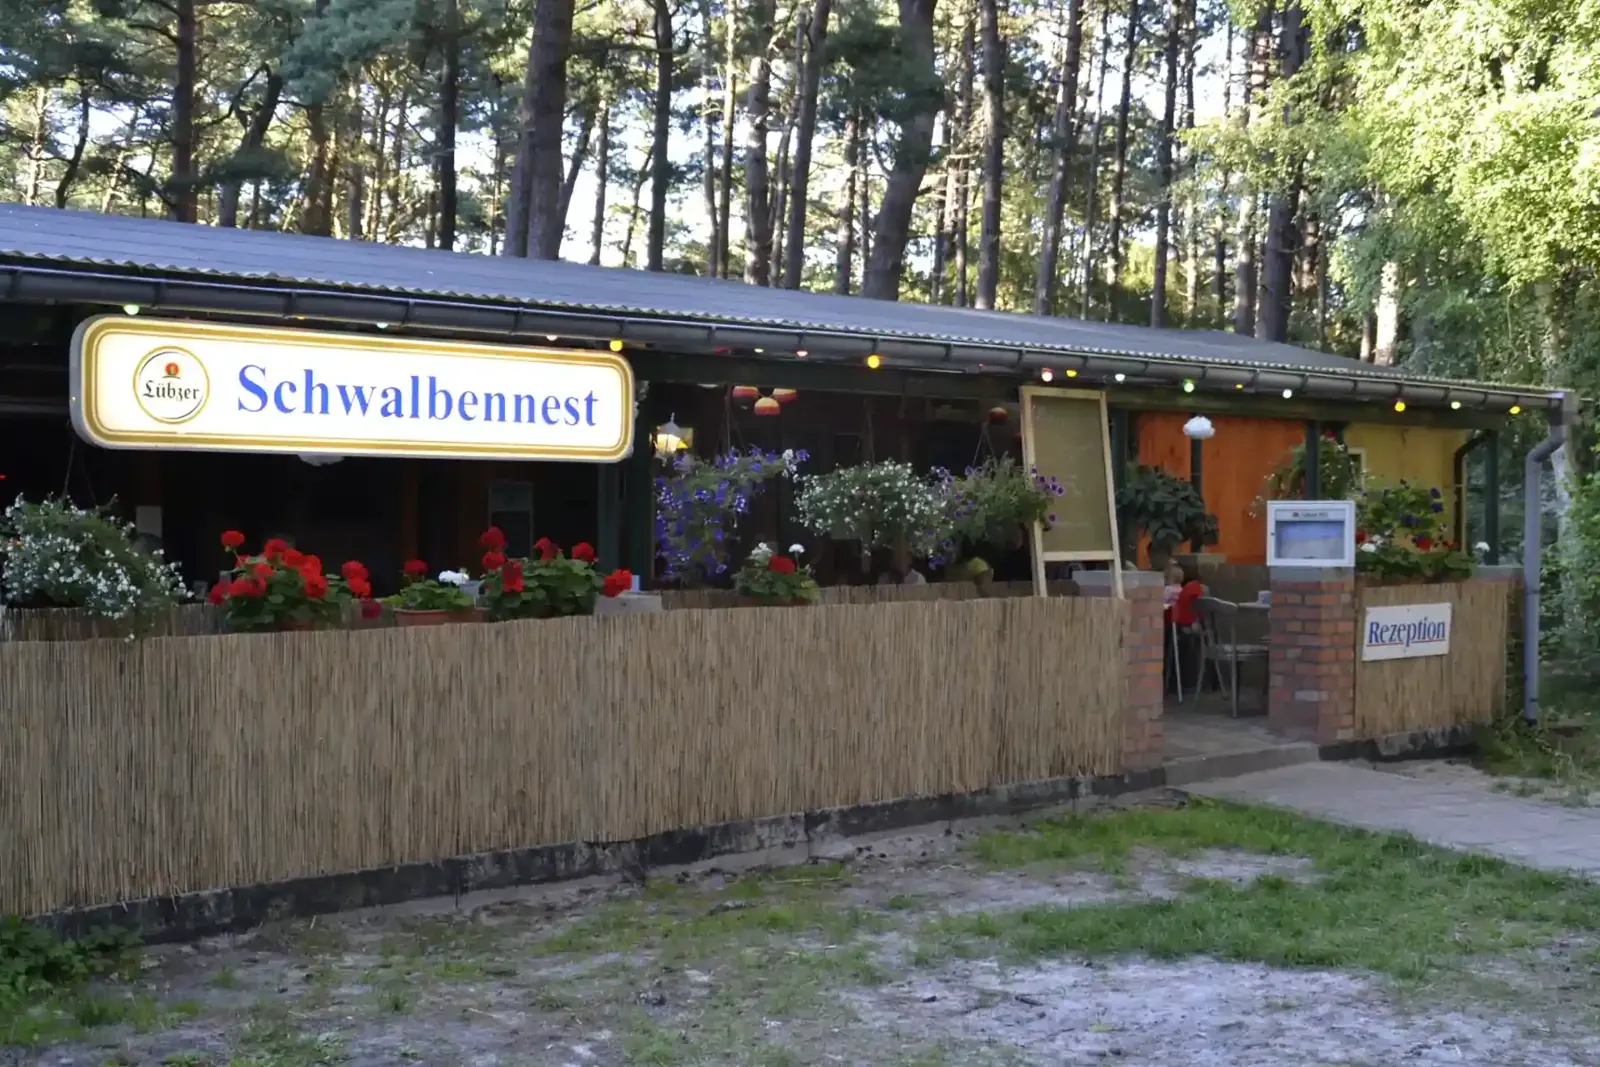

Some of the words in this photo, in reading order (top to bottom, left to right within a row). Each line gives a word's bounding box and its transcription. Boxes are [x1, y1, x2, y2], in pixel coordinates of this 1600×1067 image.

[143, 380, 200, 402] Lübzer
[238, 365, 599, 426] Schwalbennest
[1368, 616, 1446, 647] Rezeption
